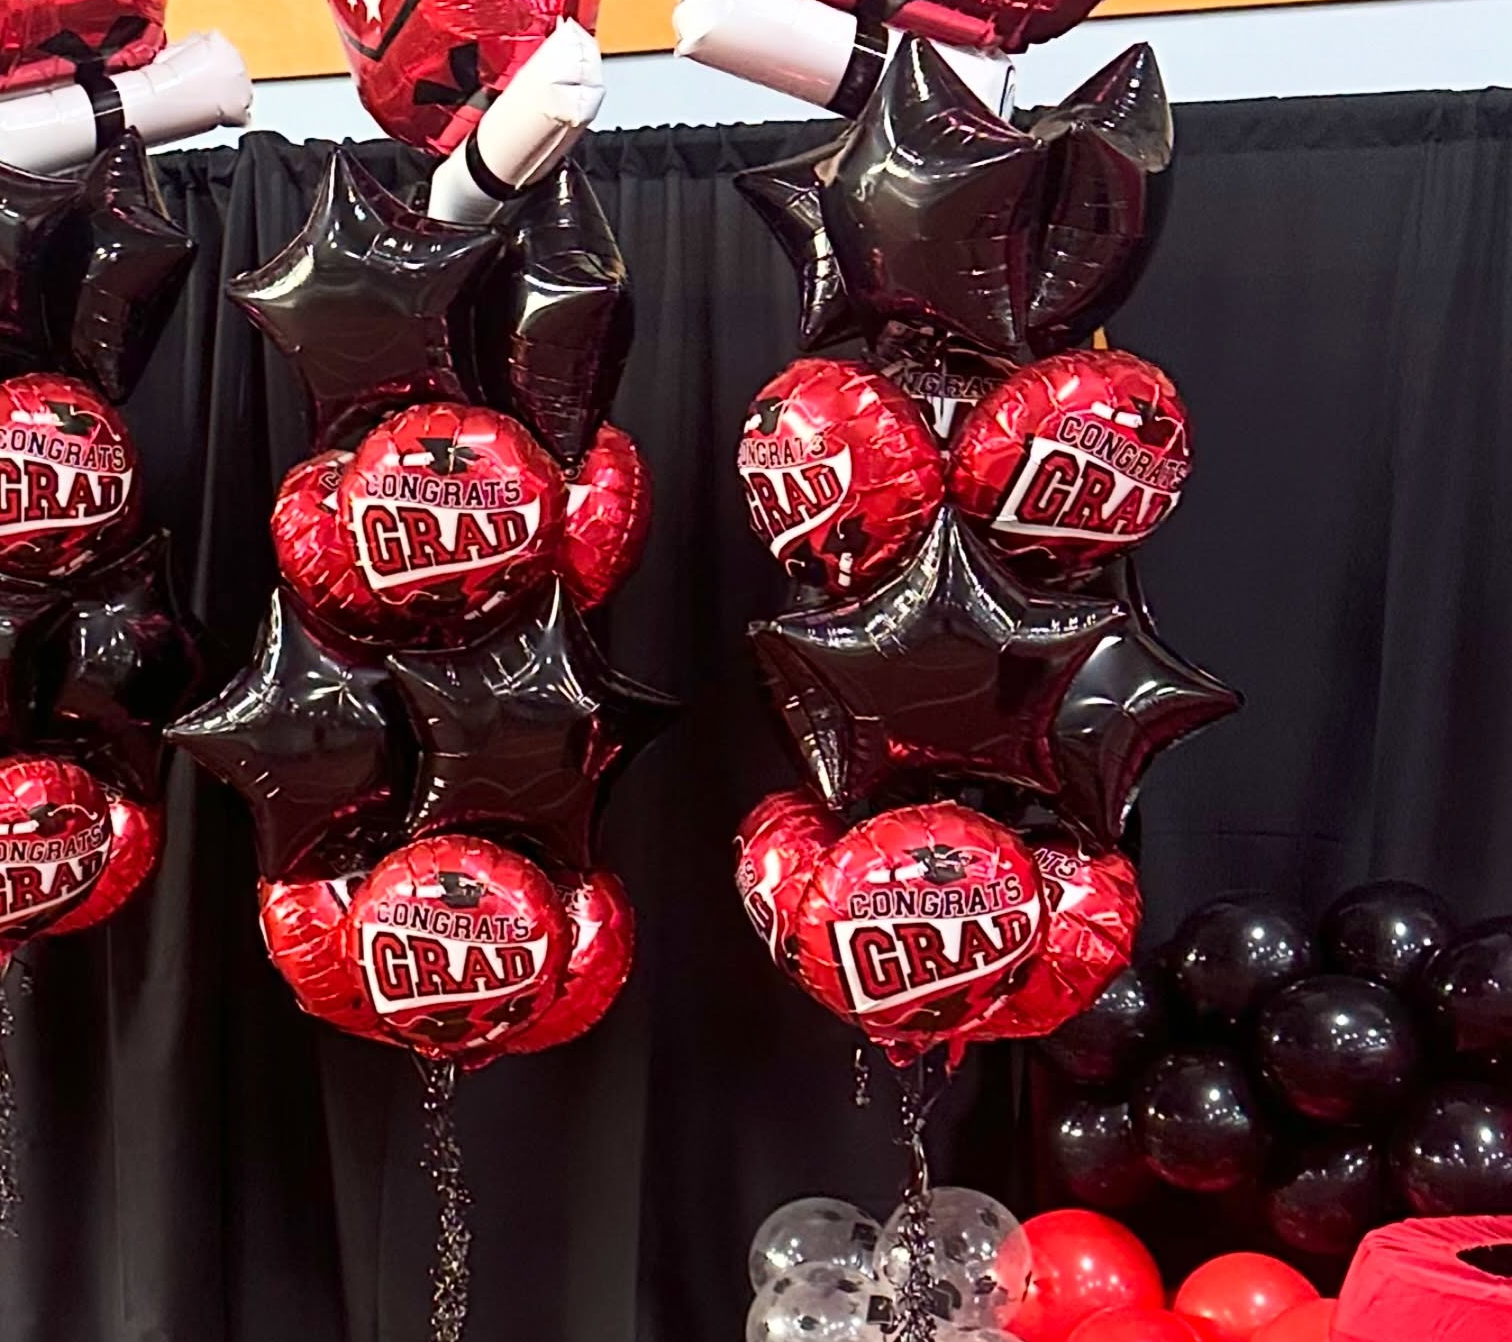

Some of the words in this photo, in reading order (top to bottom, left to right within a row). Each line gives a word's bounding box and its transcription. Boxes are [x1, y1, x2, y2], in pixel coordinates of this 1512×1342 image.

[365, 473, 522, 507] CONGRATS
[361, 504, 531, 578] GRAD
[376, 901, 532, 943] CONGRATS
[849, 874, 1023, 920] CONGRATS
[371, 931, 536, 1001] GRAD
[849, 909, 1032, 1002] GRAD
